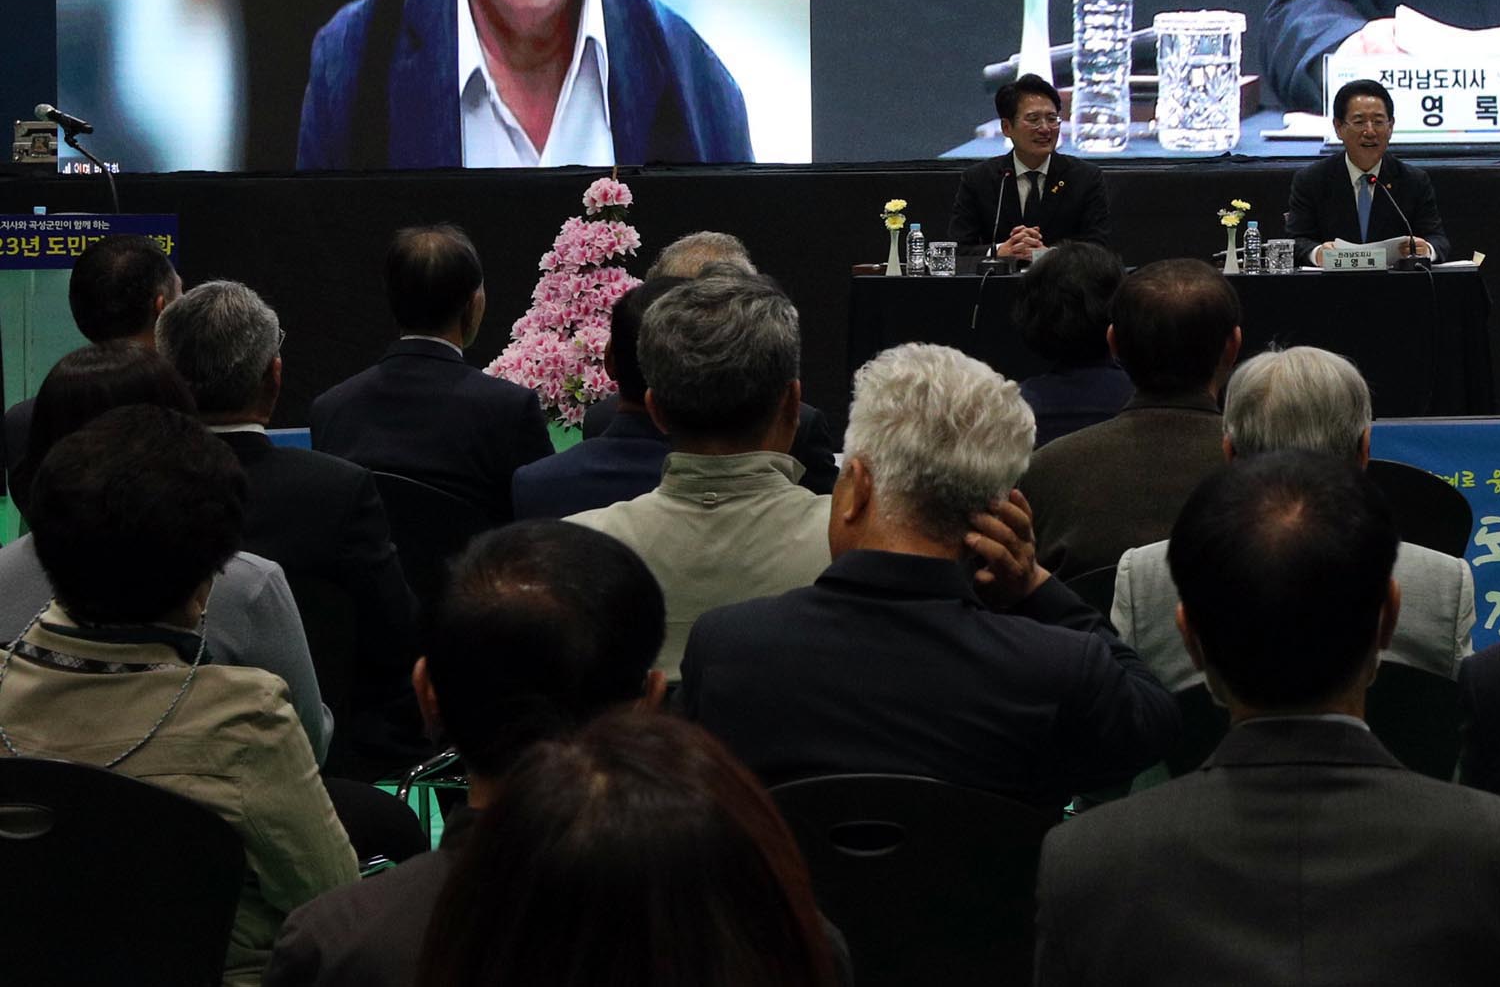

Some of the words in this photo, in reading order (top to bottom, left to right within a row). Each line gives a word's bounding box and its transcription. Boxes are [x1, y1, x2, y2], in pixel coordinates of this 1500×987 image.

[1380, 68, 1486, 91] 전라남도지사
[0, 220, 27, 230] 지사와
[28, 220, 72, 231] 곡성군민이
[74, 220, 91, 230] 함께
[93, 220, 110, 230] 하는
[0, 235, 40, 257] 3년
